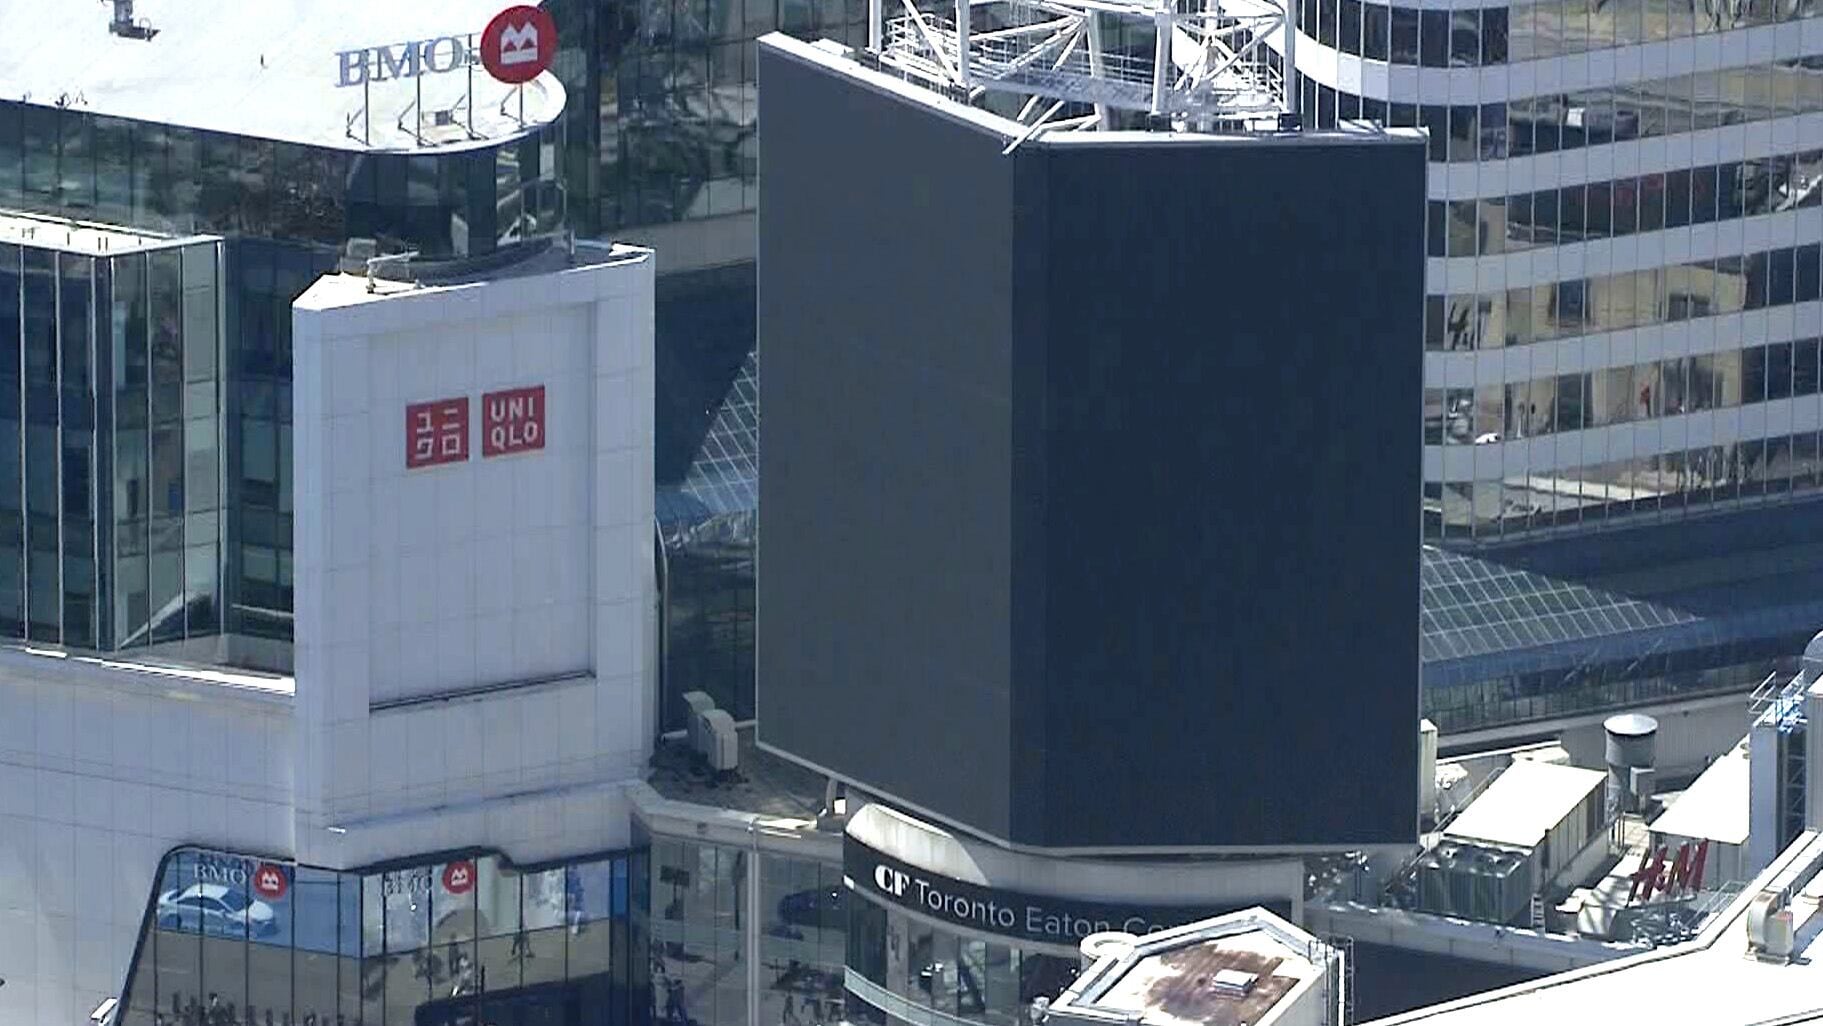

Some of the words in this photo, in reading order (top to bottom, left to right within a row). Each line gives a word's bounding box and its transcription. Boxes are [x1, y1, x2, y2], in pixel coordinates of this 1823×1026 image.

[335, 36, 464, 88] BMO
[491, 397, 534, 422] UNI
[491, 421, 538, 449] QLO
[193, 863, 247, 885] BMO
[874, 863, 910, 896] CF
[914, 878, 1016, 927] Toronto
